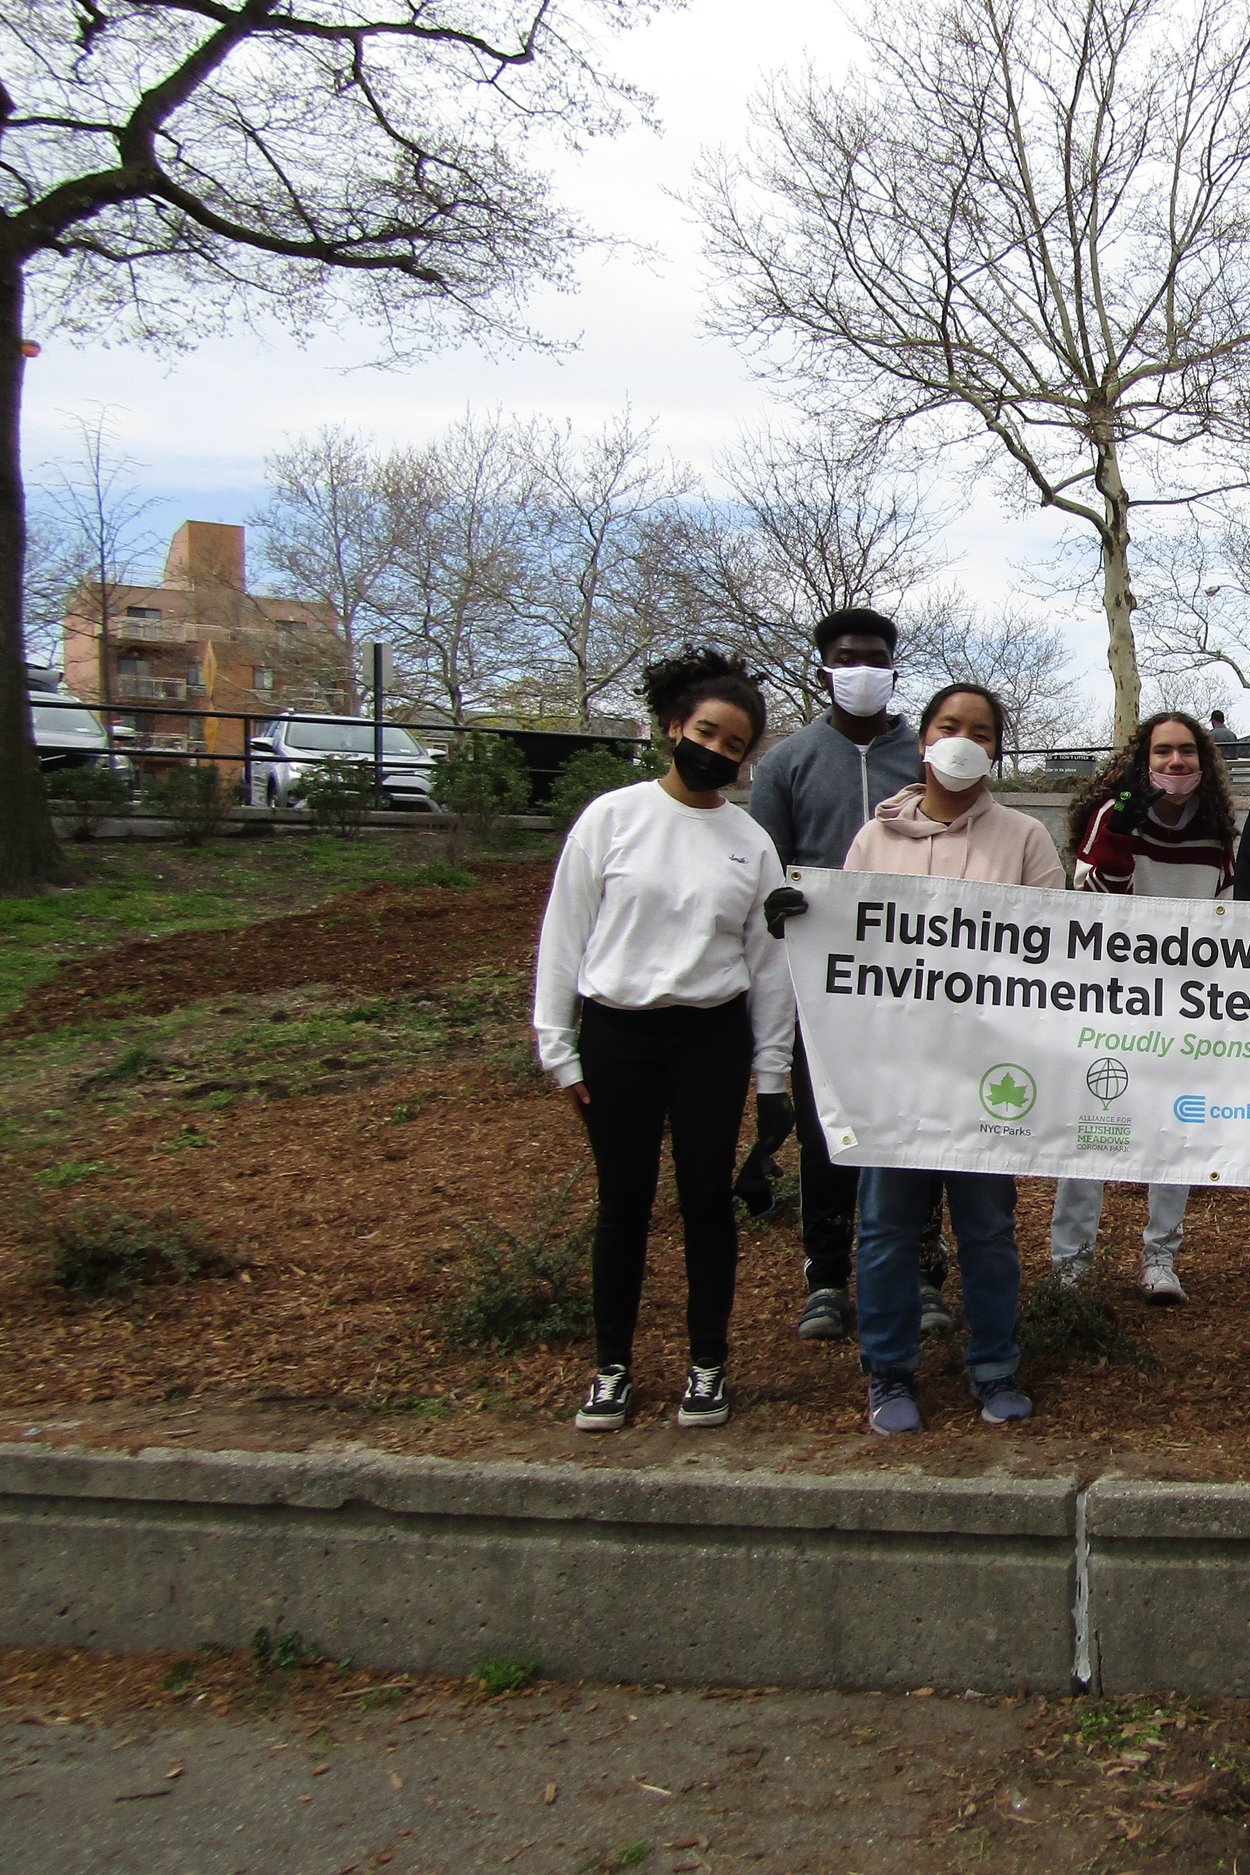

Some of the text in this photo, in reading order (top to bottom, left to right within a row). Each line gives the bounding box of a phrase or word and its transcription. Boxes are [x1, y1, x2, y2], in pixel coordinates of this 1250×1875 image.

[856, 902, 1051, 964] Flushing
[825, 953, 1163, 1016] Environmental
[1077, 1026, 1175, 1058] Proudly
[1078, 1115, 1132, 1124] ALLIANCE FOR
[980, 1123, 1032, 1136] NYC Parks
[1078, 1125, 1131, 1135] FLUSHING
[1077, 1134, 1130, 1145] MEADOWS
[1076, 1143, 1130, 1152] CORONA PARK
